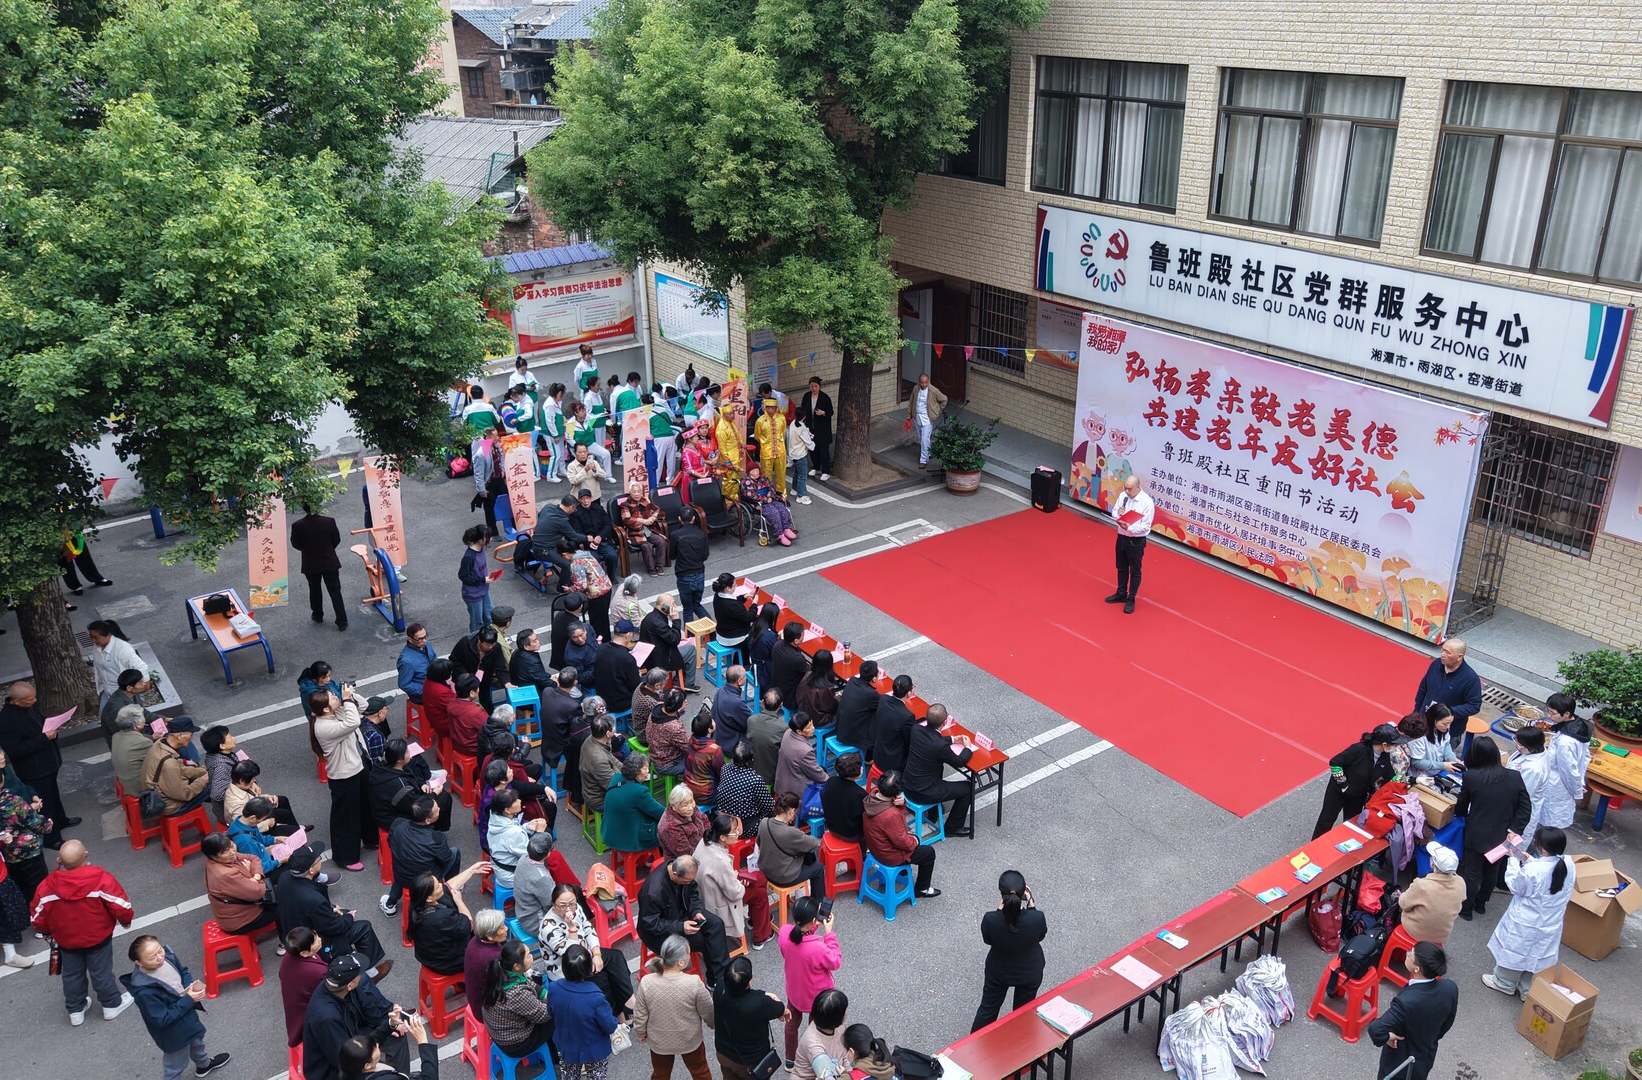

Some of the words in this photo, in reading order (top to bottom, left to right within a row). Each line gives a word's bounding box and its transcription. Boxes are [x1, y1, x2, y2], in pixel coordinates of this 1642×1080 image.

[526, 277, 623, 301] 深入学习贯彻习近平法治思想
[1149, 241, 1530, 348] 鲁班殿社区党群服务中心
[1149, 274, 1164, 288] LU
[1168, 279, 1193, 295] BAN
[1197, 285, 1227, 302] DIAN
[1232, 292, 1257, 309] SHE
[1263, 299, 1283, 314] QU
[1288, 304, 1327, 324] DANG
[1333, 314, 1365, 333] QUN
[1371, 322, 1391, 338] FU
[1399, 328, 1424, 346] WU
[1431, 335, 1490, 362] ZHONG
[1497, 350, 1528, 370] XIN
[1087, 336, 1123, 355] 我的家
[1125, 351, 1399, 461] 弘扬孝亲敬老美德
[1142, 395, 1425, 514] 共建老年友好社会
[1160, 441, 1360, 525] 鲁班殿社区重阳节活动
[1186, 523, 1275, 566] 湘潭市雨湖区人民法院
